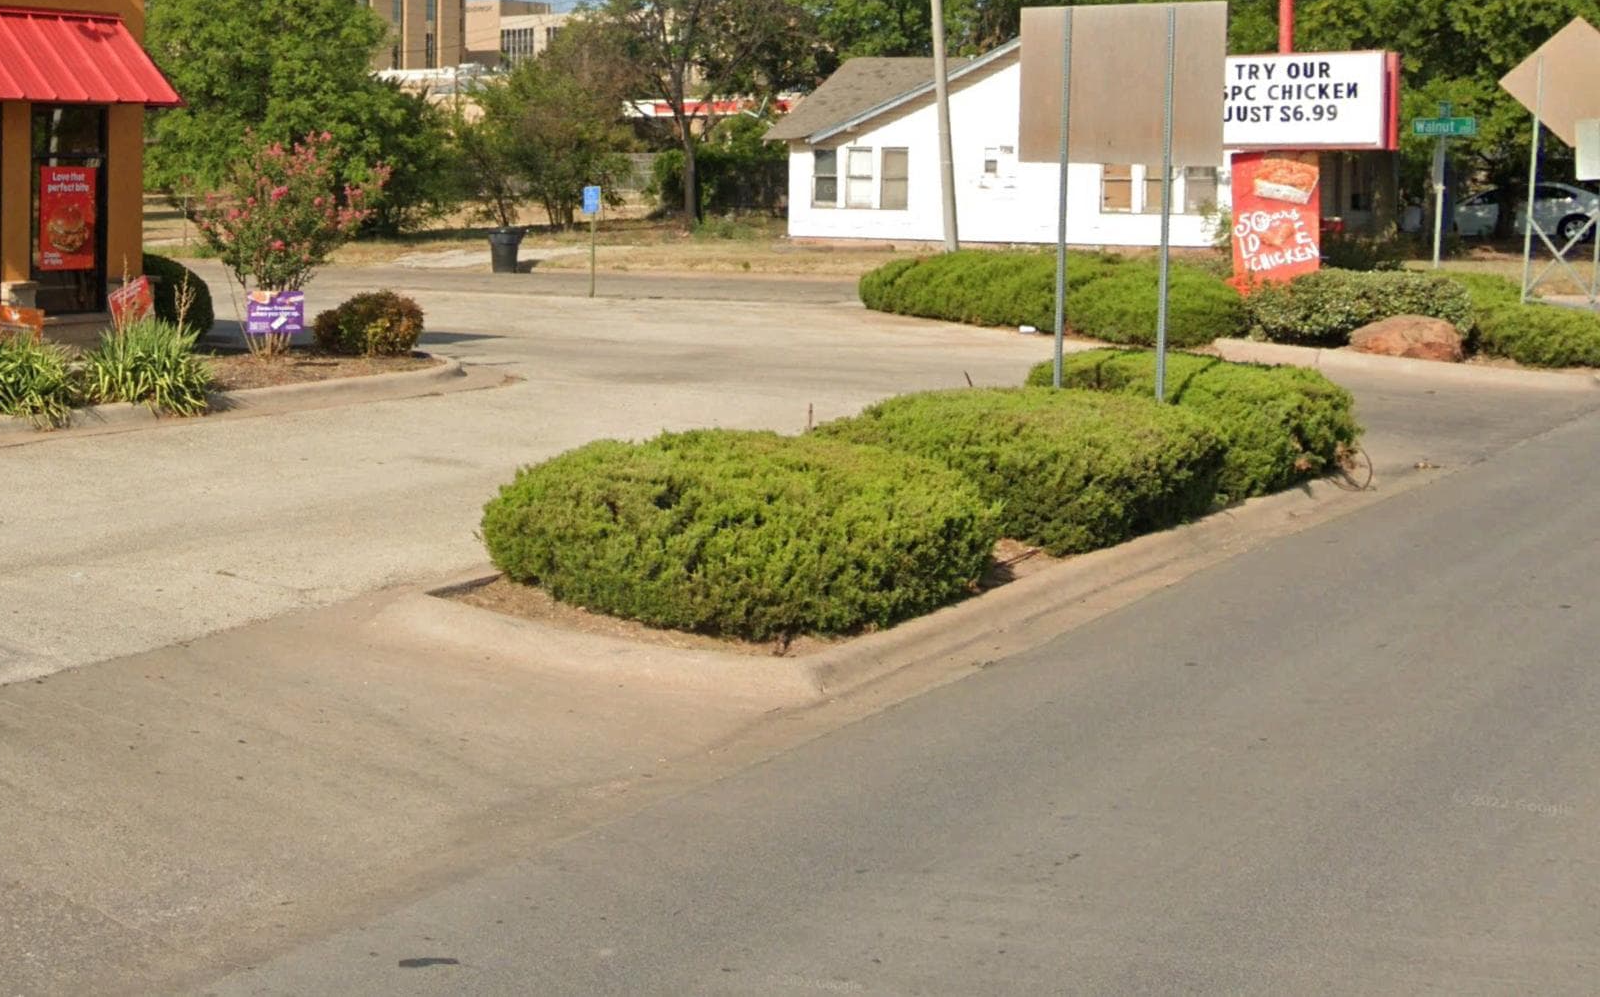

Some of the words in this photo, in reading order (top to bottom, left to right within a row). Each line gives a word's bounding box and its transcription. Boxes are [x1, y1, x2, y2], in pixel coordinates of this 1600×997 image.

[1235, 63, 1276, 80] TRY
[1287, 62, 1330, 79] OUR
[1268, 82, 1358, 100] CHICKEN
[1223, 105, 1274, 122] JUST
[1415, 120, 1455, 133] Walnut
[52, 172, 69, 182] Love
[48, 183, 75, 193] perfect
[1251, 242, 1319, 271] CHICKEN
